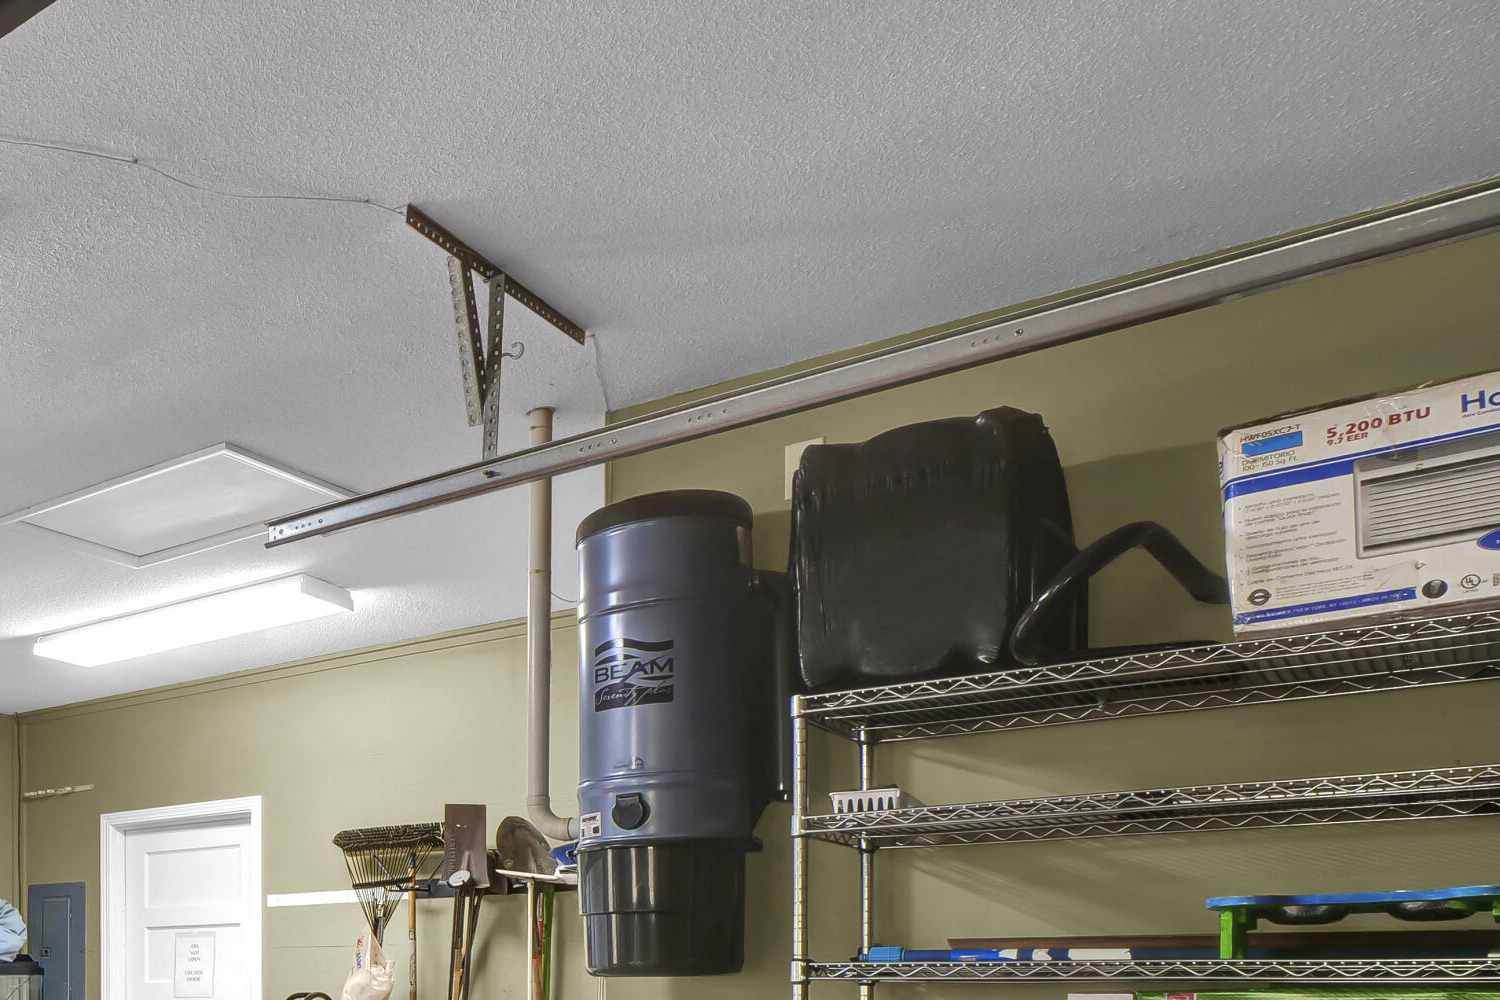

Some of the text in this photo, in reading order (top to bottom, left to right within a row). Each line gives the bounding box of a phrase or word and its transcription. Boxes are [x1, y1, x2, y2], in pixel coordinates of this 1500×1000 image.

[1326, 406, 1431, 441] 5,200 BTU
[1346, 432, 1368, 442] EER
[594, 657, 674, 684] BEAM
